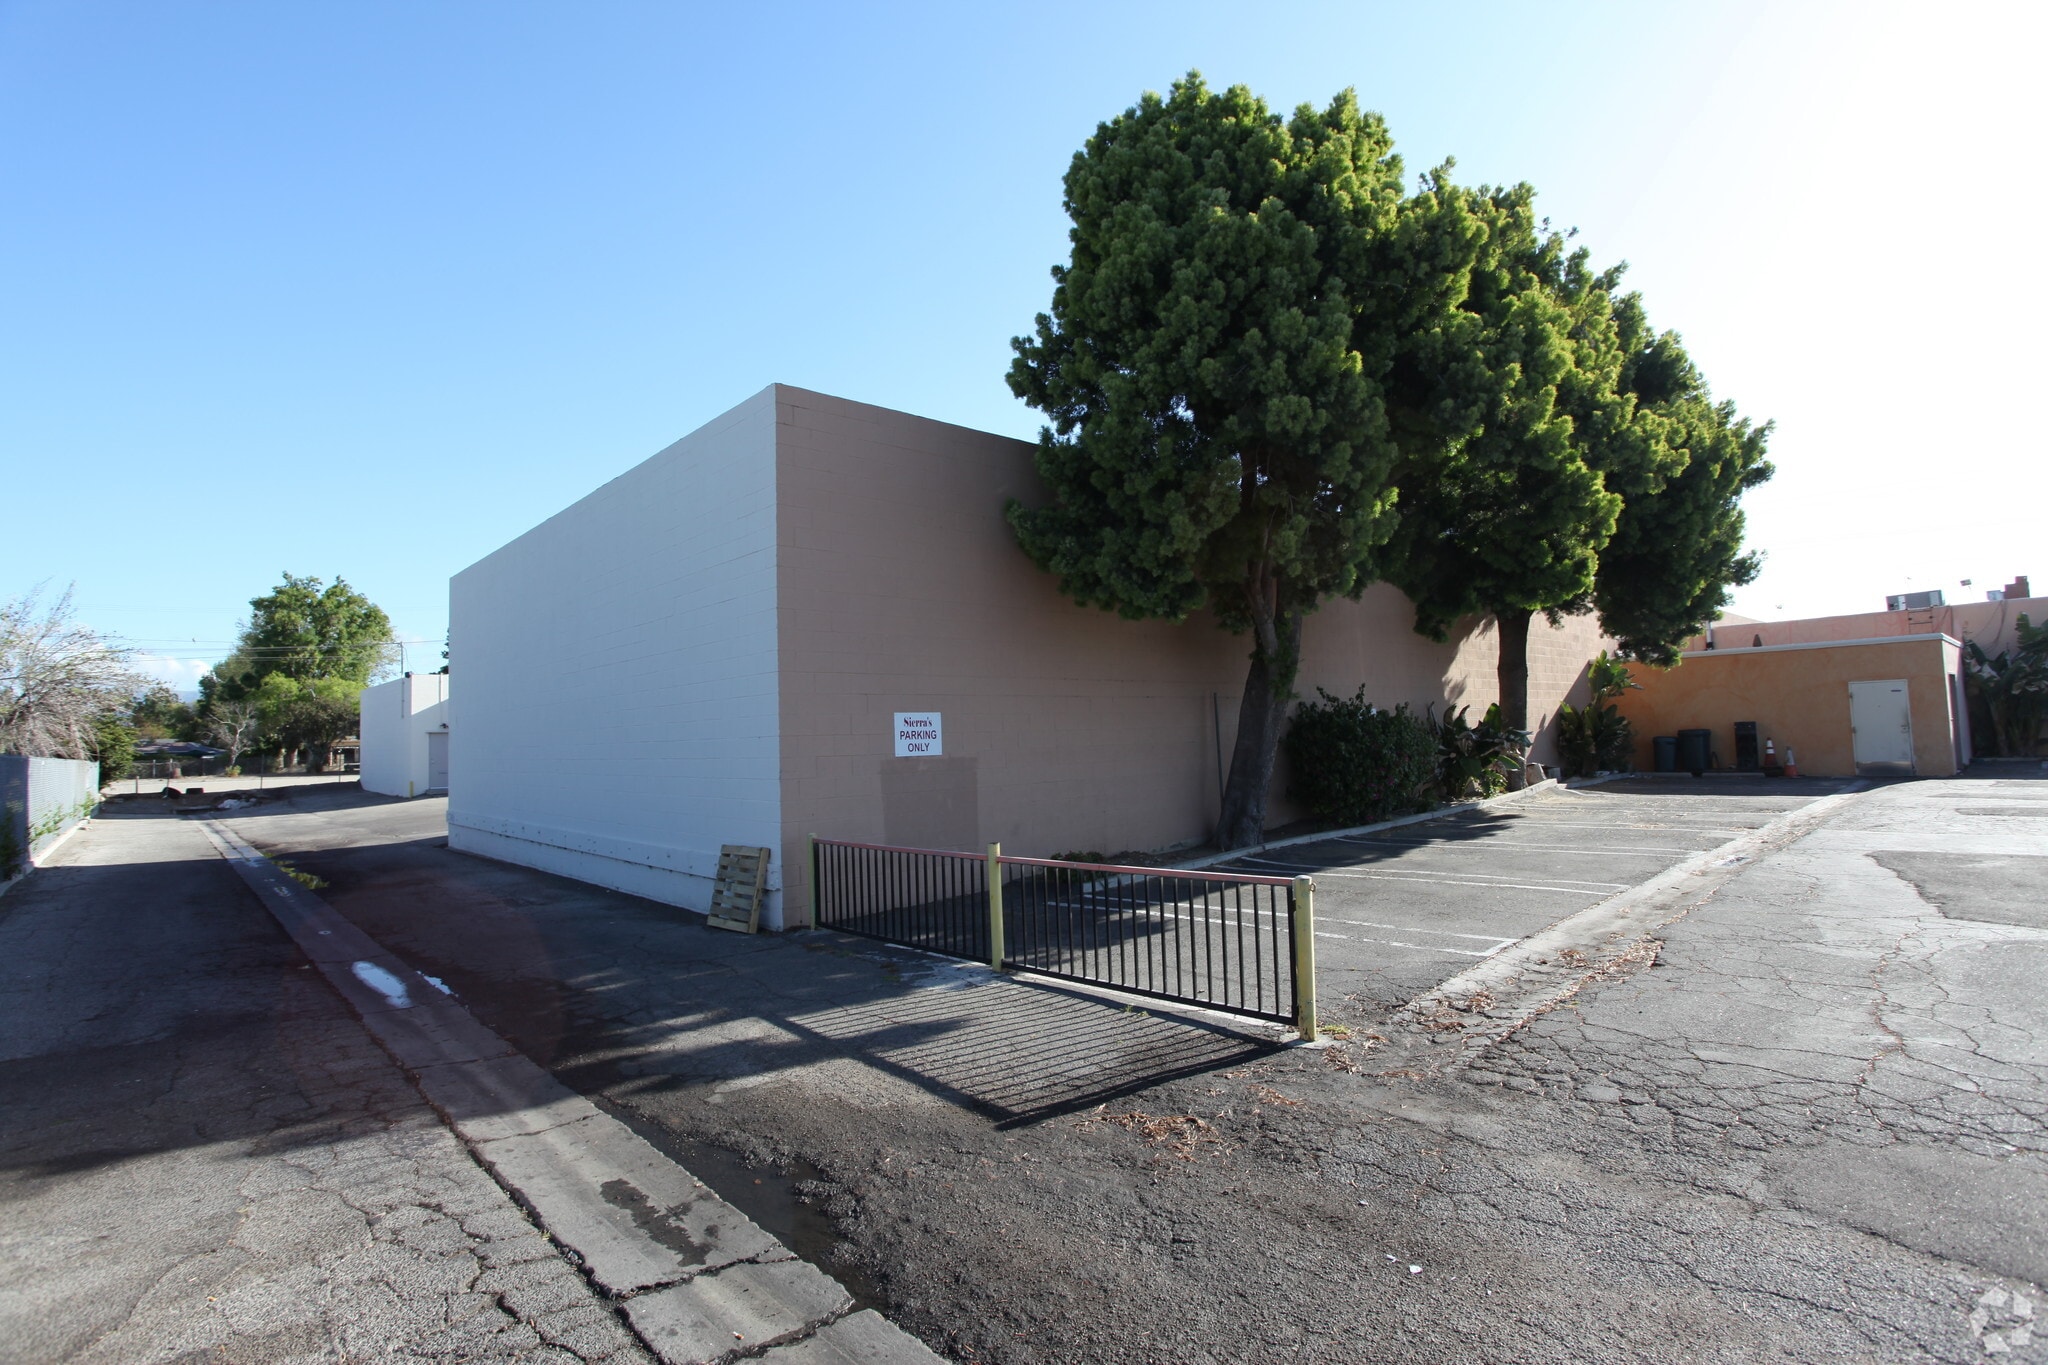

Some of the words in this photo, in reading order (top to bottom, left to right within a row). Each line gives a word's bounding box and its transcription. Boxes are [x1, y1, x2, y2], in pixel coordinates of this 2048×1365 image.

[904, 717, 932, 727] Sierra's
[900, 730, 937, 740] PARKING
[908, 743, 930, 752] ONLY
